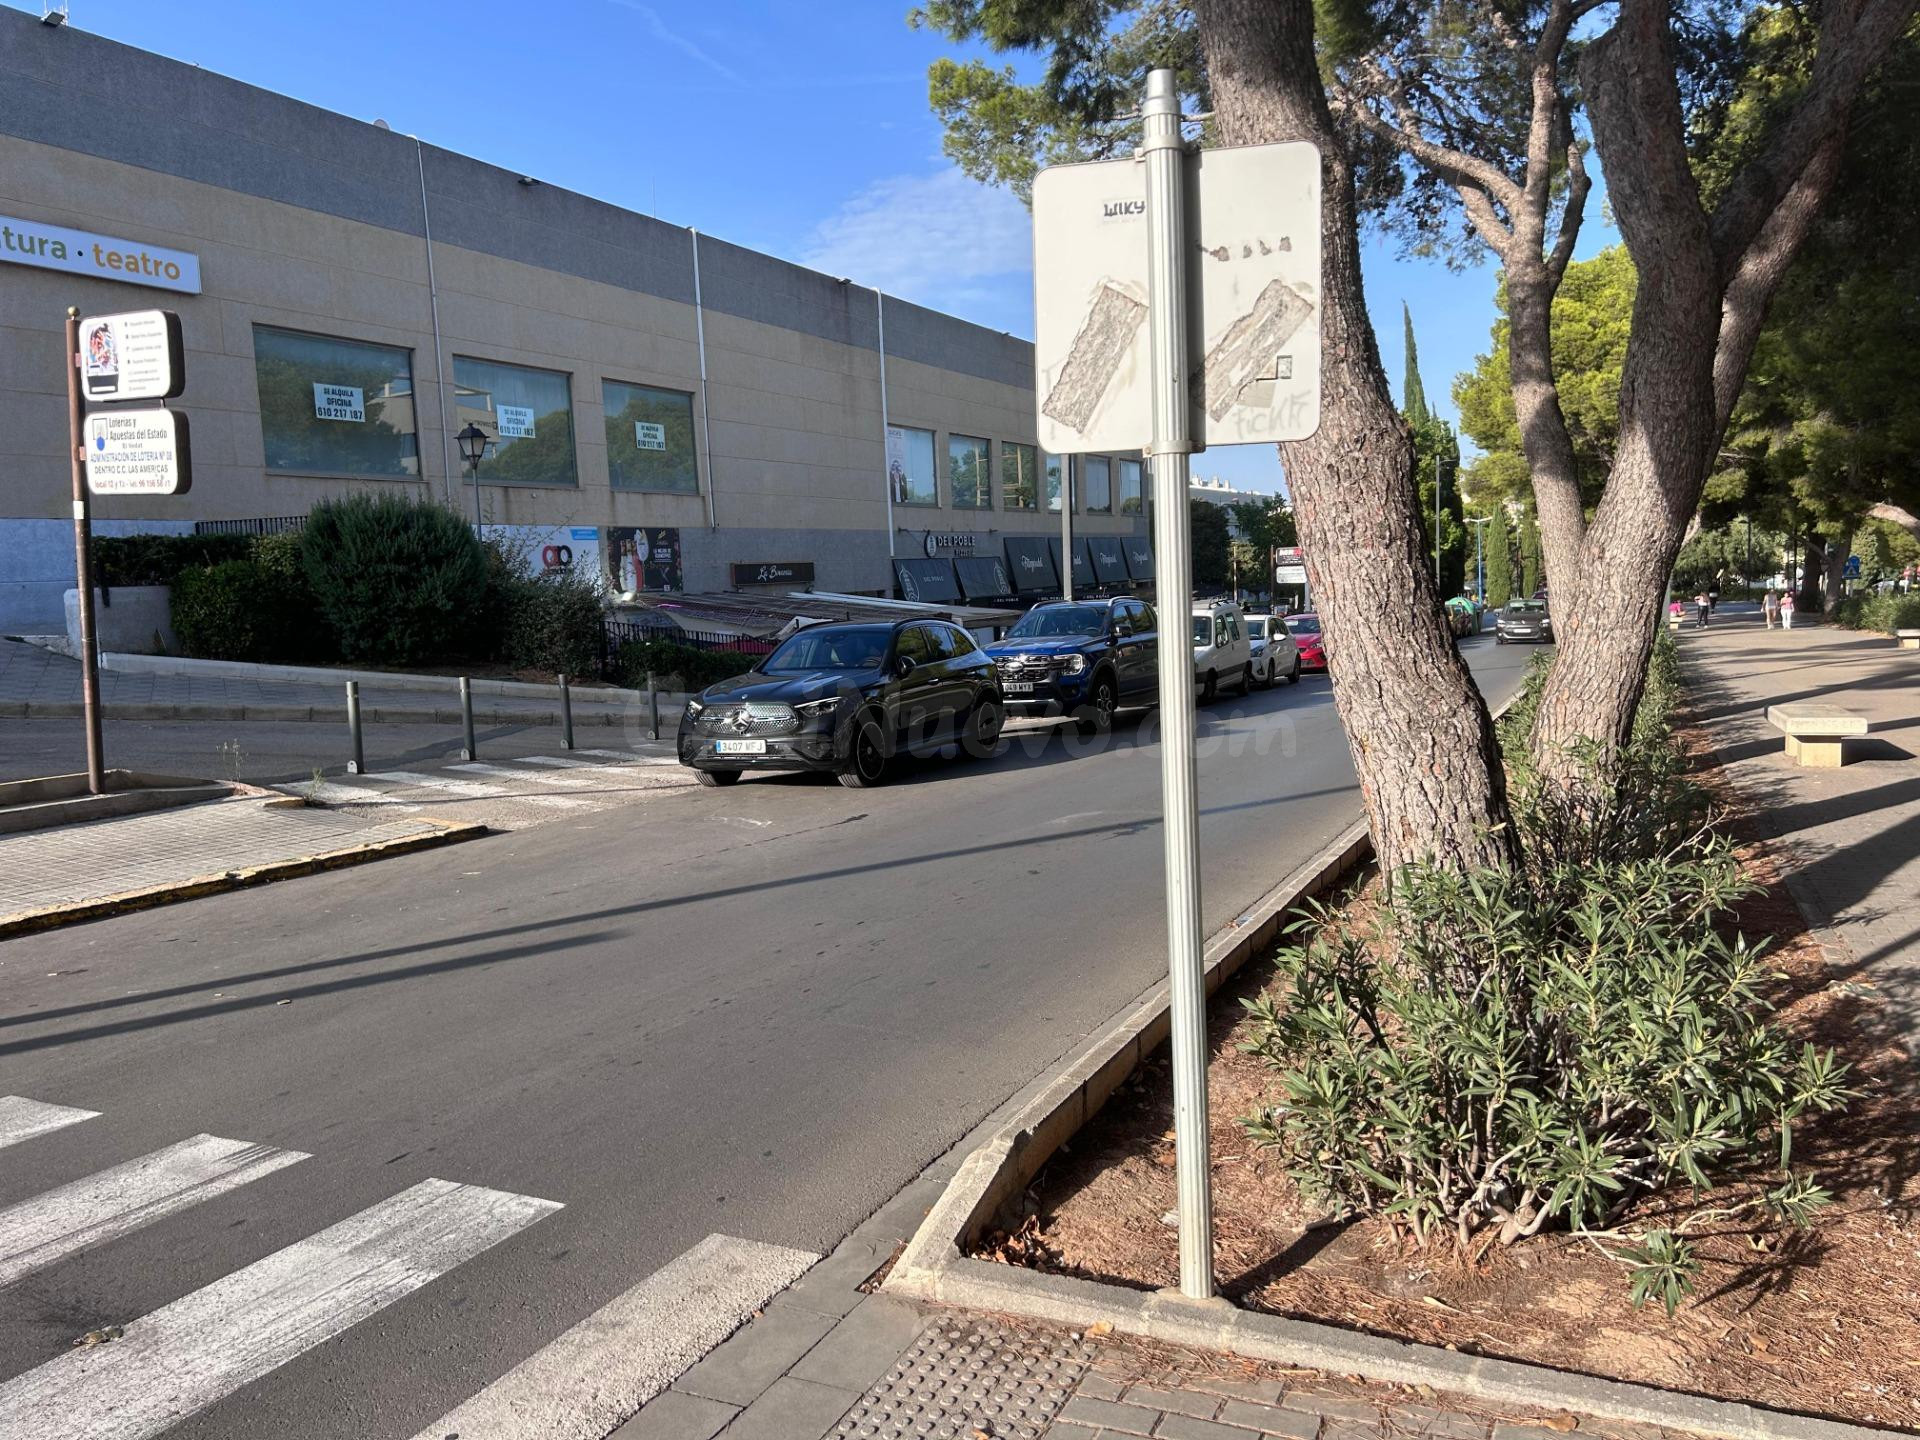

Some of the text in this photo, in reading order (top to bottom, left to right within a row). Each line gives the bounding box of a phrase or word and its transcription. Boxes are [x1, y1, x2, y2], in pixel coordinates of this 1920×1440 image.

[0, 226, 180, 280] tura teatro
[331, 388, 354, 397] ALQUILA
[317, 407, 363, 420] 610 217 187
[110, 428, 168, 442] Apuestas del Estado
[94, 465, 115, 474] DENTRO
[128, 465, 139, 473] LAS
[938, 536, 953, 546] DEL
[954, 535, 976, 546] POBLE
[722, 742, 743, 751] 3407
